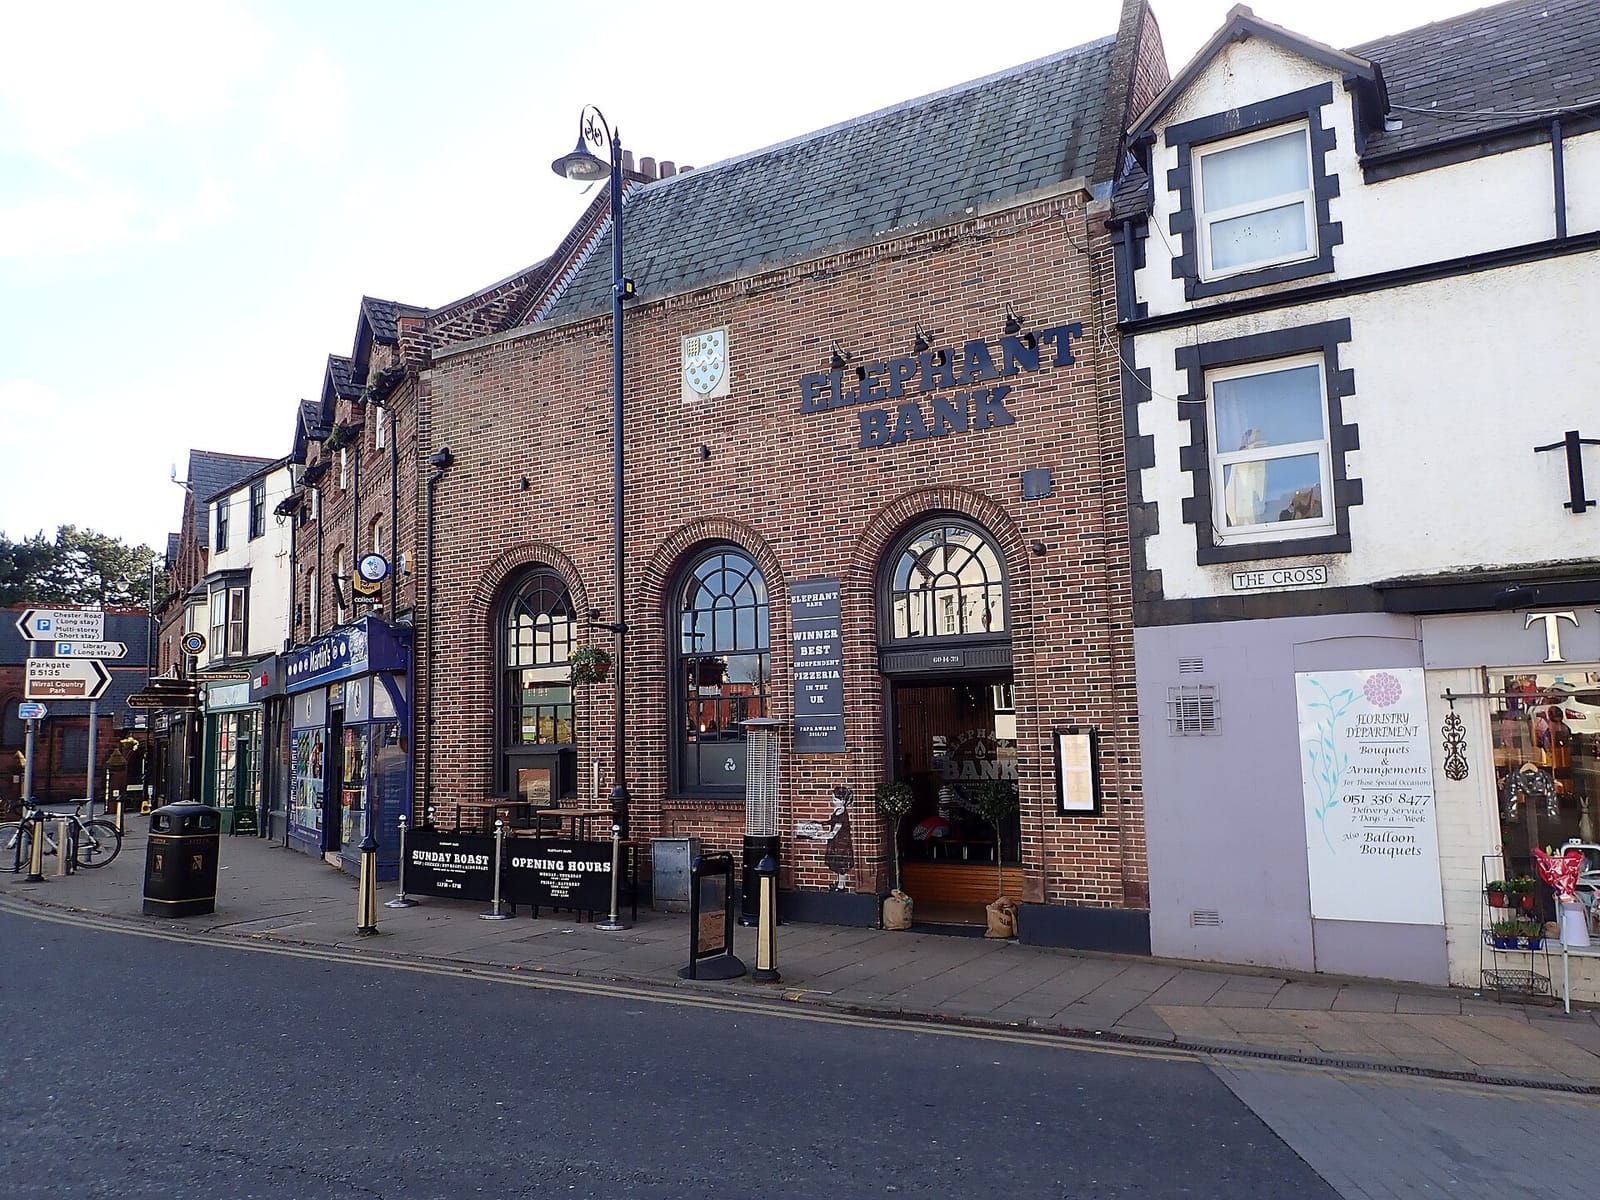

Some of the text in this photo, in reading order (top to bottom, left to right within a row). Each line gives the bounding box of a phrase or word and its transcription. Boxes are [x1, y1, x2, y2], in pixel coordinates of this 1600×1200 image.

[800, 322, 1083, 414] ELEPHANT
[858, 385, 1016, 449] BANK
[1236, 568, 1322, 586] THE CROSS
[791, 592, 838, 603] ELEPHANT
[792, 630, 838, 641] WINNER
[800, 645, 830, 656] BEST
[310, 644, 330, 672] Martin's
[794, 670, 840, 680] PIZZERIA
[1356, 712, 1409, 726] FLORISTRY
[1346, 726, 1418, 738] DEPARTMENT
[1360, 746, 1410, 757] Bouquets
[944, 760, 1018, 780] BANK
[1346, 766, 1427, 777] Arrangements
[1343, 793, 1431, 806] 0151 336 8477
[1352, 806, 1389, 815] Delivery
[1363, 831, 1415, 843] Balloon
[412, 850, 489, 865] SUNDAY ROAST
[1360, 844, 1422, 859] Bouquets
[512, 857, 611, 872] OPENING HOURS
